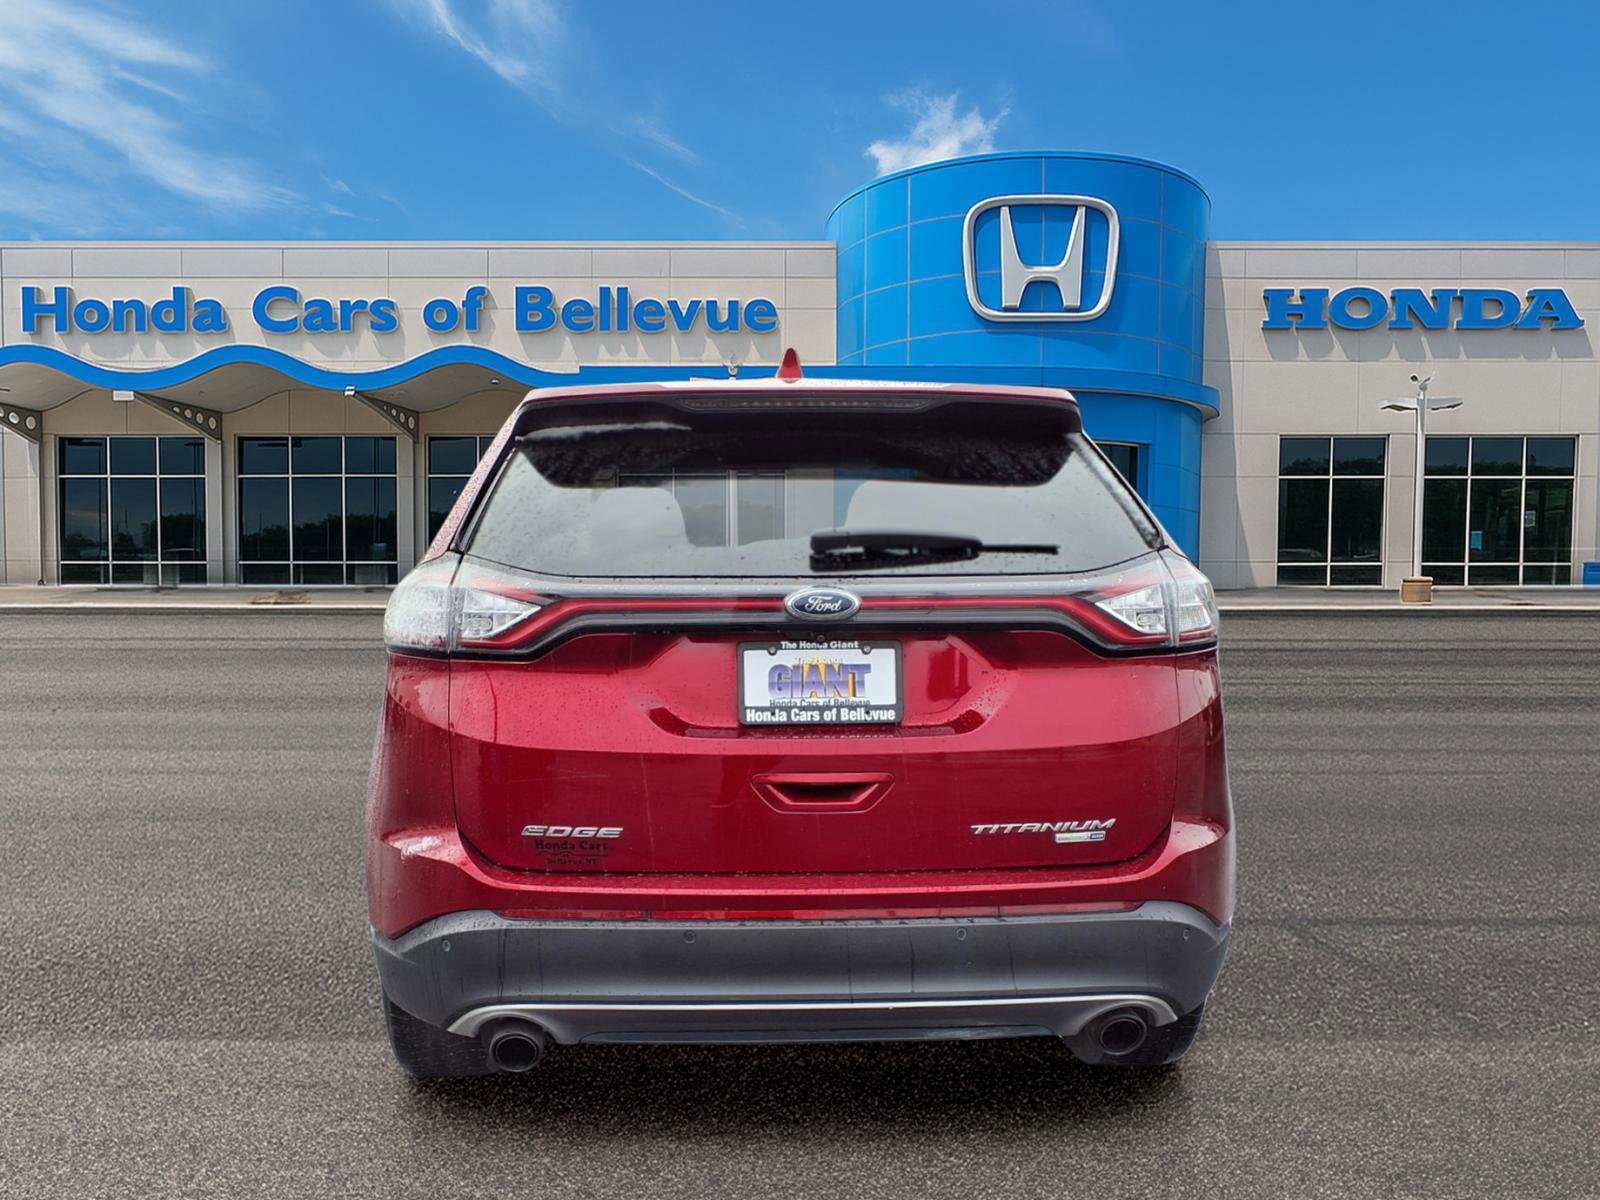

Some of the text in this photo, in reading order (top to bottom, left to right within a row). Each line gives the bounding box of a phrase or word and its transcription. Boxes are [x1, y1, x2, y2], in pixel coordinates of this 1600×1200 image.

[21, 285, 779, 334] Honda Cars of Bellevue
[1262, 287, 1585, 330] HONDA
[805, 595, 842, 612] Ford
[781, 641, 798, 649] The
[830, 641, 859, 649] Giant
[768, 664, 871, 698] GIANT
[746, 709, 787, 722] Honda
[790, 708, 820, 722] Cars
[823, 708, 837, 722] of
[521, 825, 624, 838] EDGE
[970, 818, 1117, 835] TITANIUM
[535, 839, 576, 850] Honda
